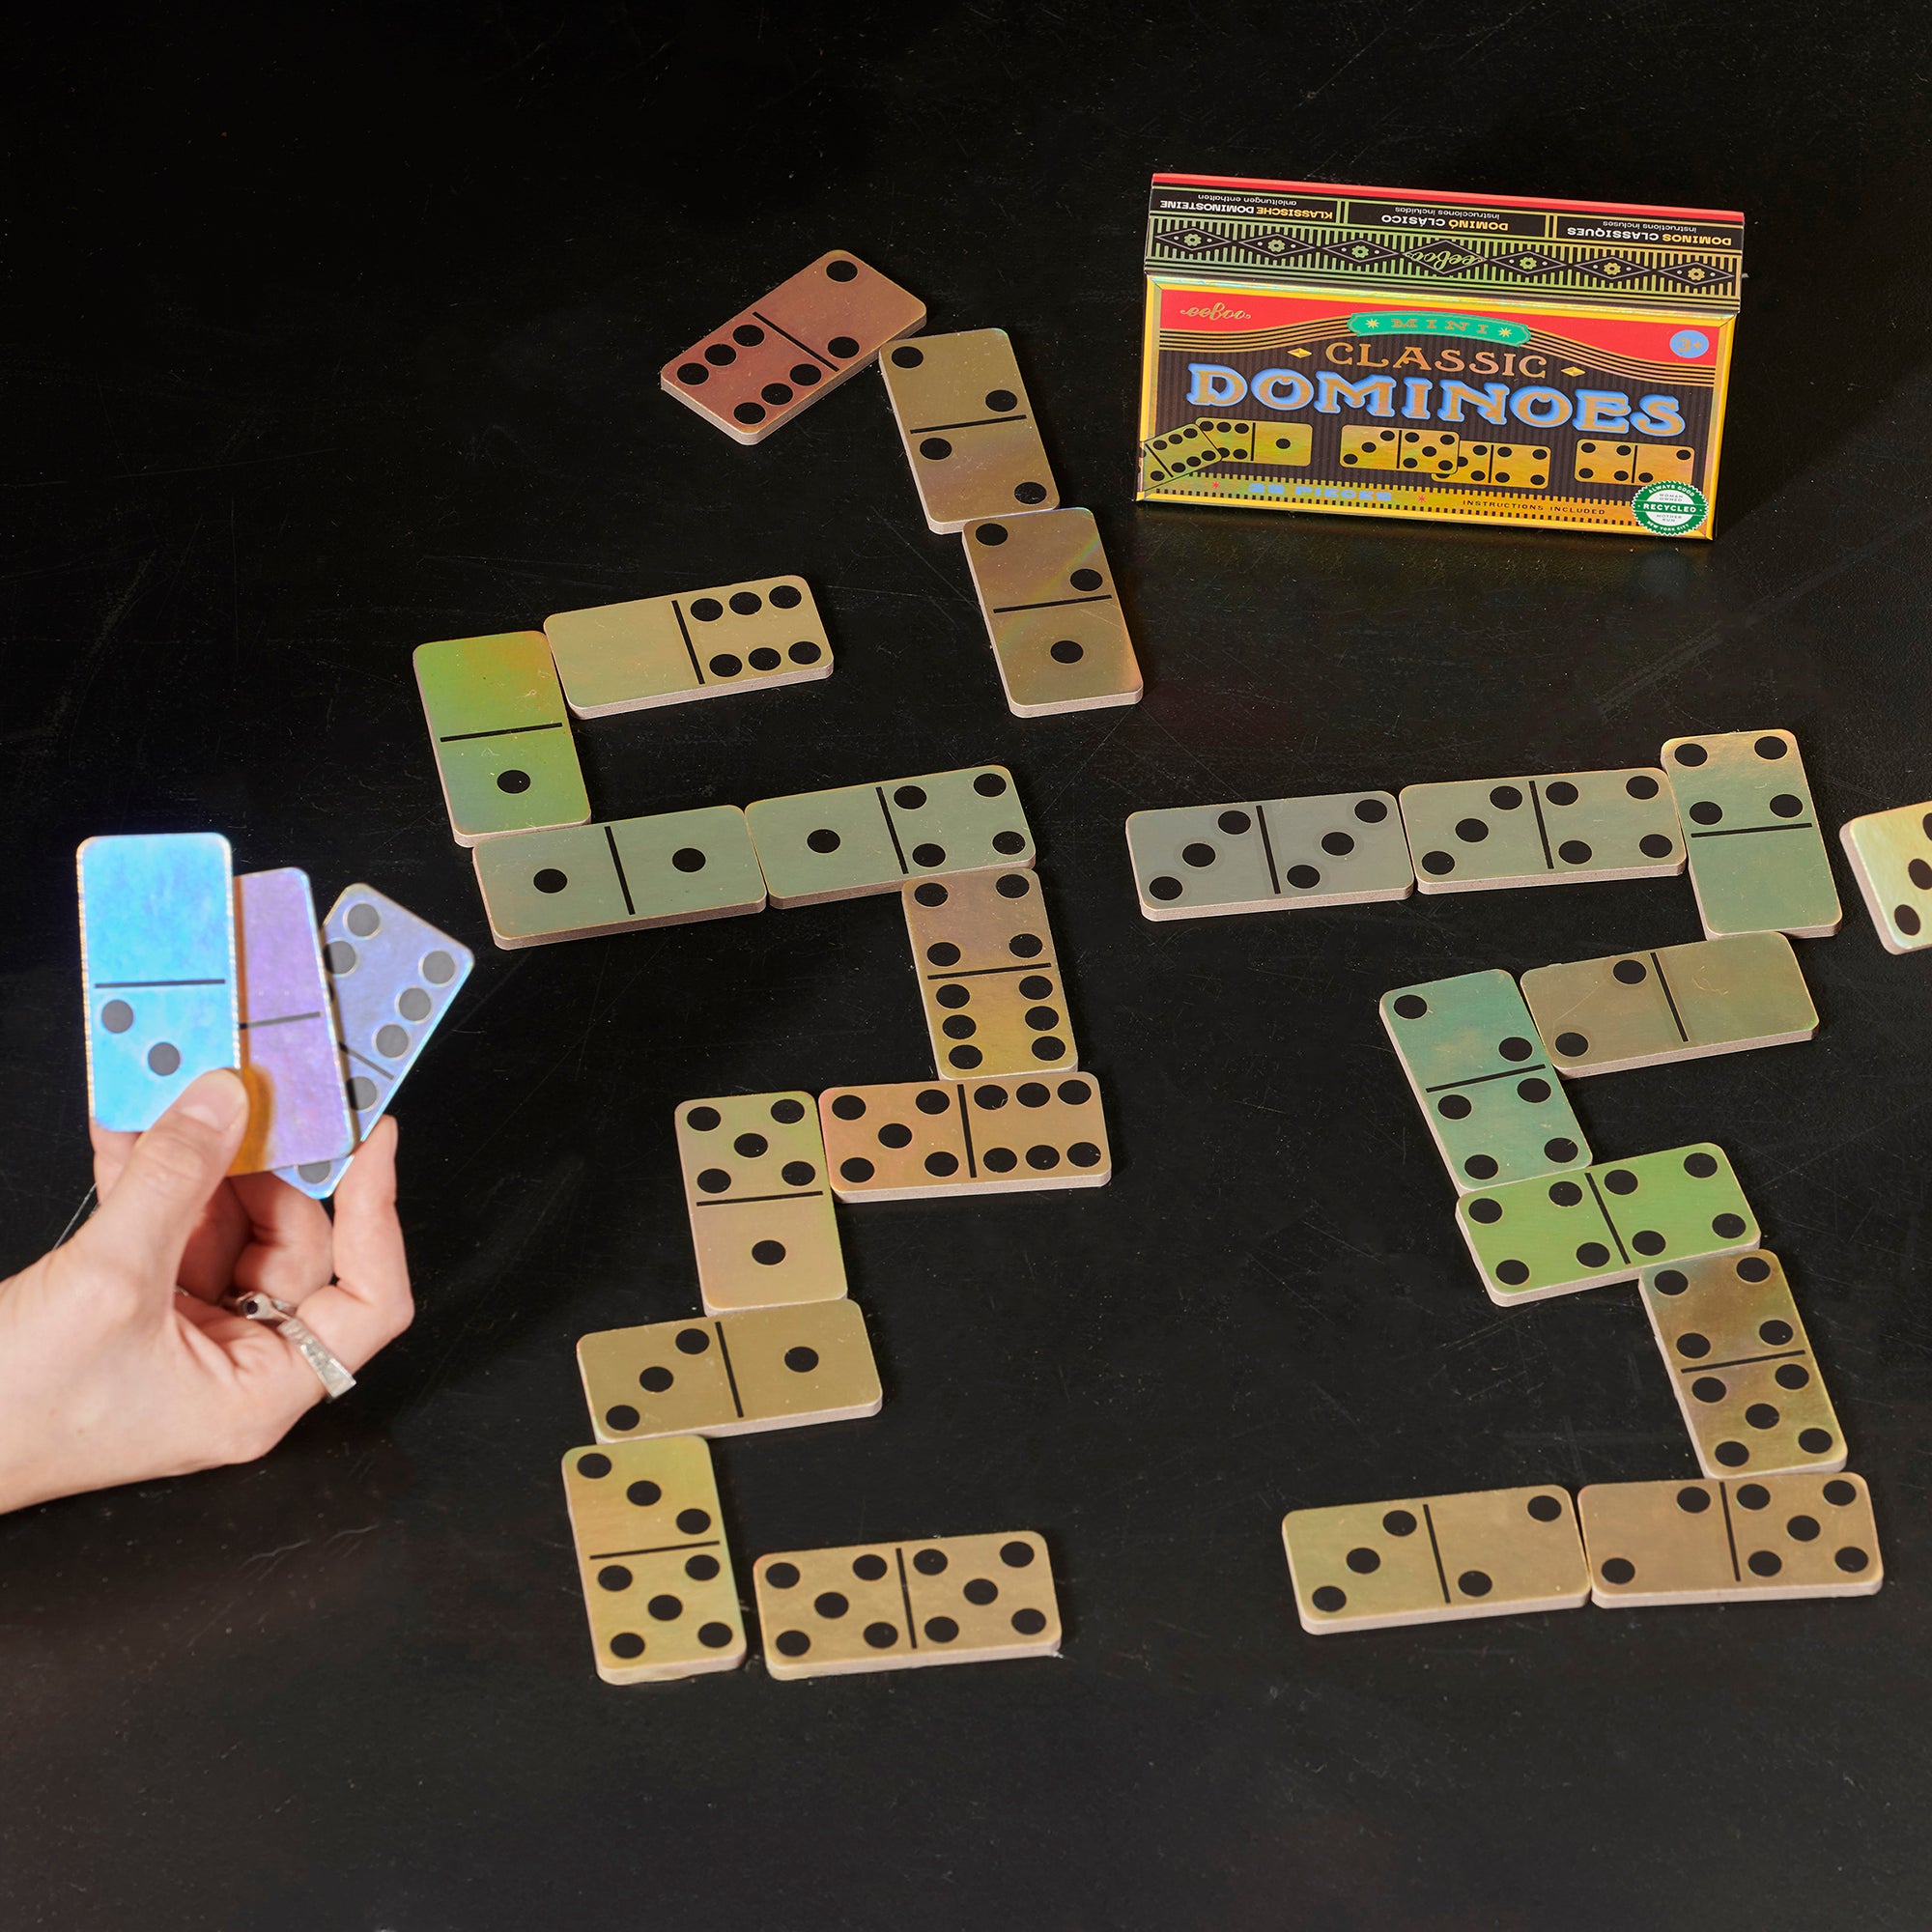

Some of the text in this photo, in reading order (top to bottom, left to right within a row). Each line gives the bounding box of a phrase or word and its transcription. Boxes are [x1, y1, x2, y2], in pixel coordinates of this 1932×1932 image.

[1159, 200, 1333, 219] KLASSISCHE DOMINOSTEINE
[1243, 196, 1297, 207] anleitungen
[1395, 206, 1500, 220] instrucciones incluidas
[1380, 213, 1509, 231] DOMINÓ CLÁSICO
[1603, 220, 1697, 233] instructions incluses
[1567, 226, 1732, 246] DOMINOS CLASSIQUES
[1390, 318, 1490, 334] MINI
[1677, 336, 1702, 353] 3+
[1325, 341, 1547, 379] CLASSIC
[1186, 362, 1686, 437] DOMINOES
[1294, 486, 1392, 501] PIECES
[1648, 485, 1695, 497] ALWAYS GOOD
[1463, 499, 1605, 515] INSTRUCTIONS INCLUDED
[1643, 503, 1696, 513] RECYCLED
